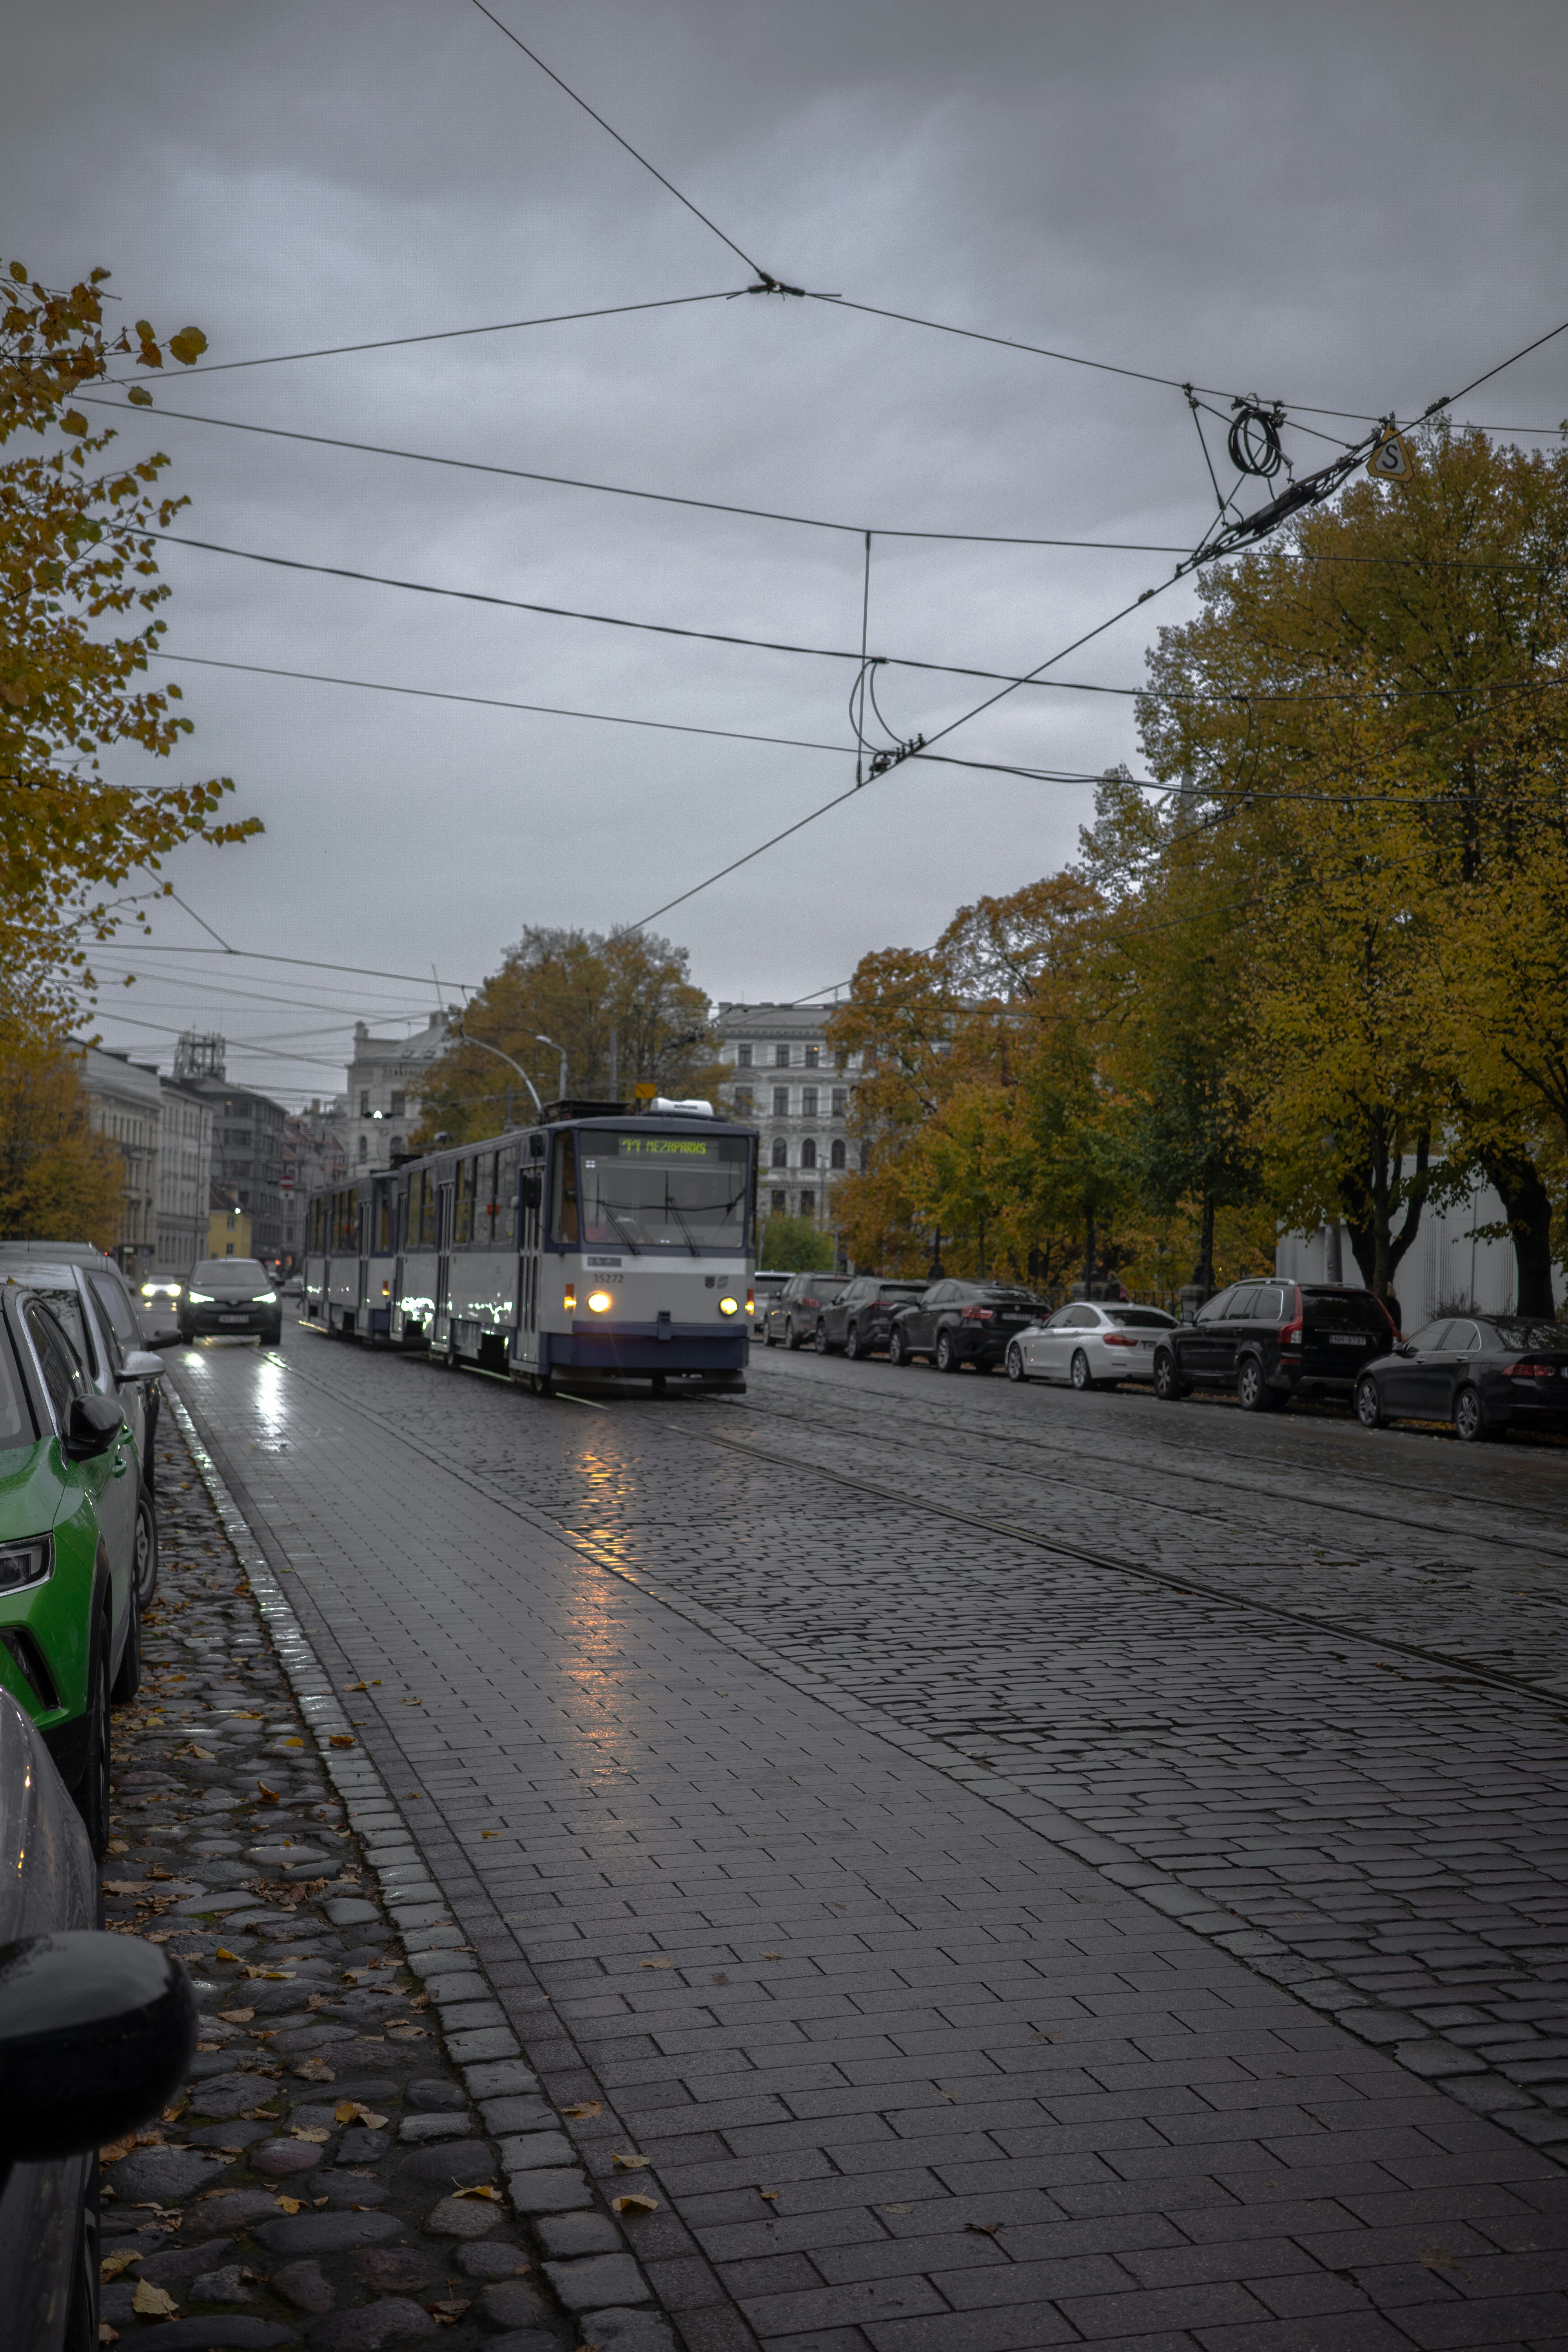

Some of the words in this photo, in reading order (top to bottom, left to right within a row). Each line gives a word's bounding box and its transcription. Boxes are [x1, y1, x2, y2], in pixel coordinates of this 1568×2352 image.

[1381, 444, 1399, 470] S
[621, 1139, 641, 1152] 11
[592, 1274, 624, 1284] 35272
